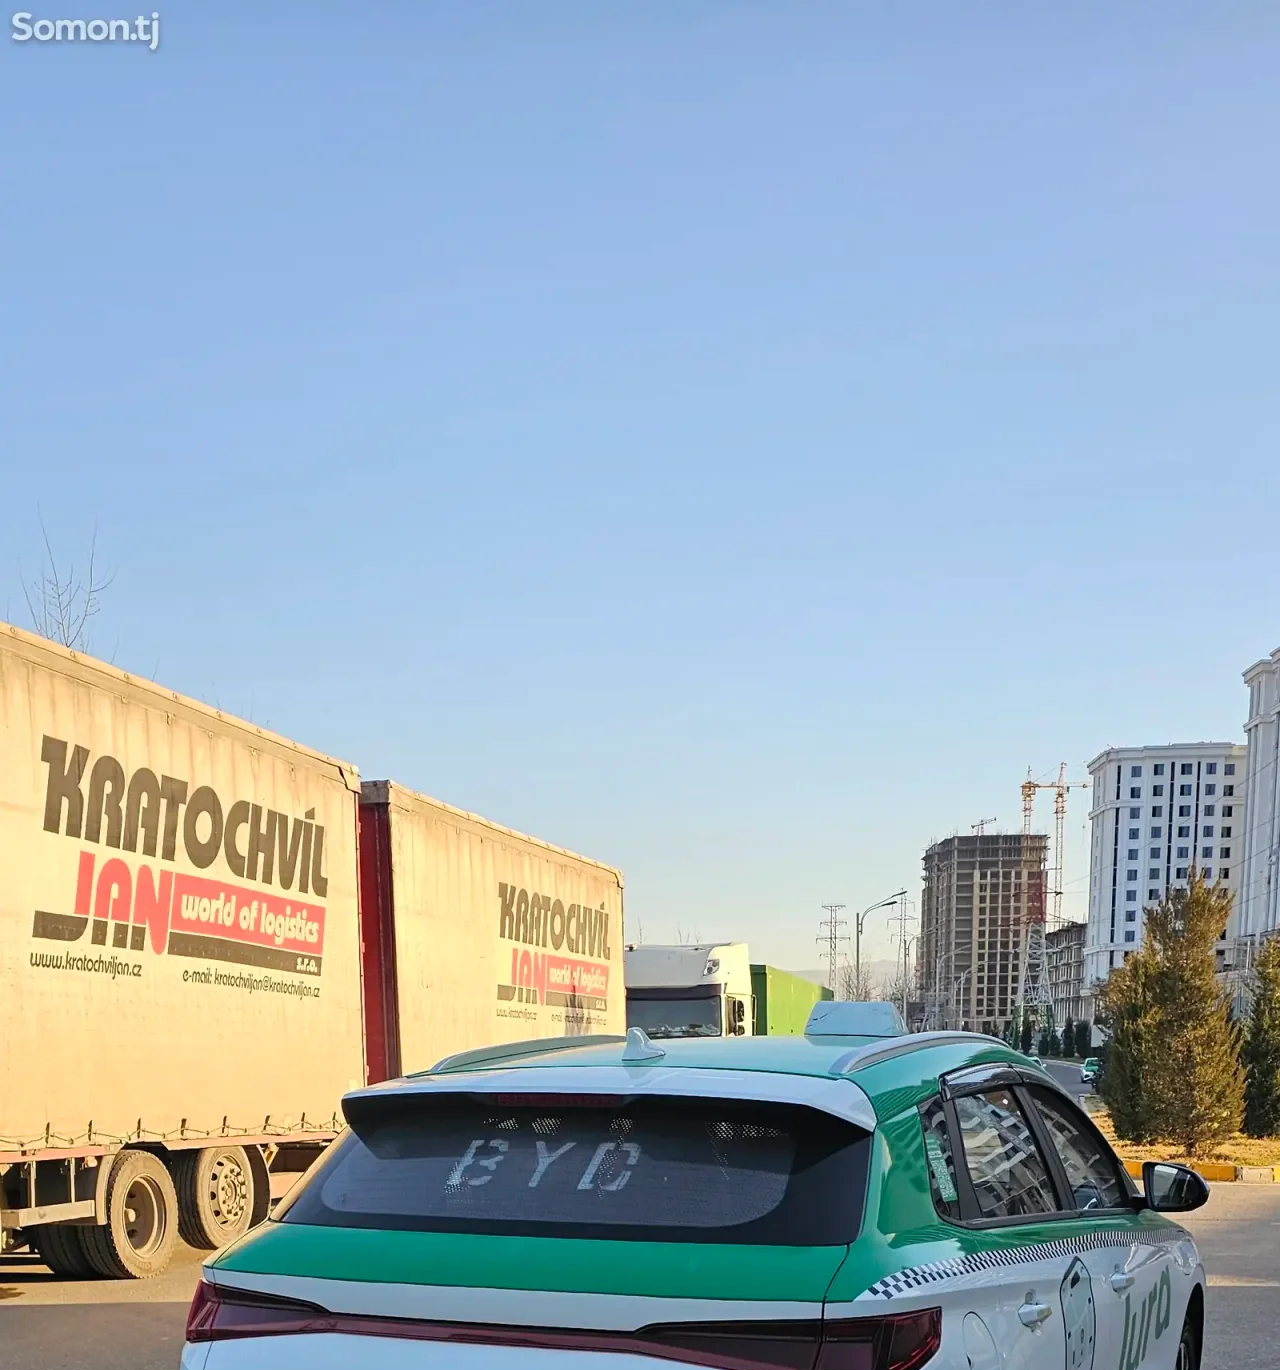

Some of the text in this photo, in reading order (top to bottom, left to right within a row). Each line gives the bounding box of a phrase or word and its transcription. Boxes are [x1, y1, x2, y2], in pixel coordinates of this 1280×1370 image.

[41, 734, 328, 898] KRATOCHVÍL
[32, 850, 174, 955] JAN
[181, 892, 319, 945] world of logistics
[498, 882, 610, 960] KRATOCHVÍL
[30, 951, 142, 980] www.kratochviljan.cz
[183, 968, 212, 985] e-mail:
[296, 956, 318, 972] s.r.o.
[497, 948, 547, 1006] JAN
